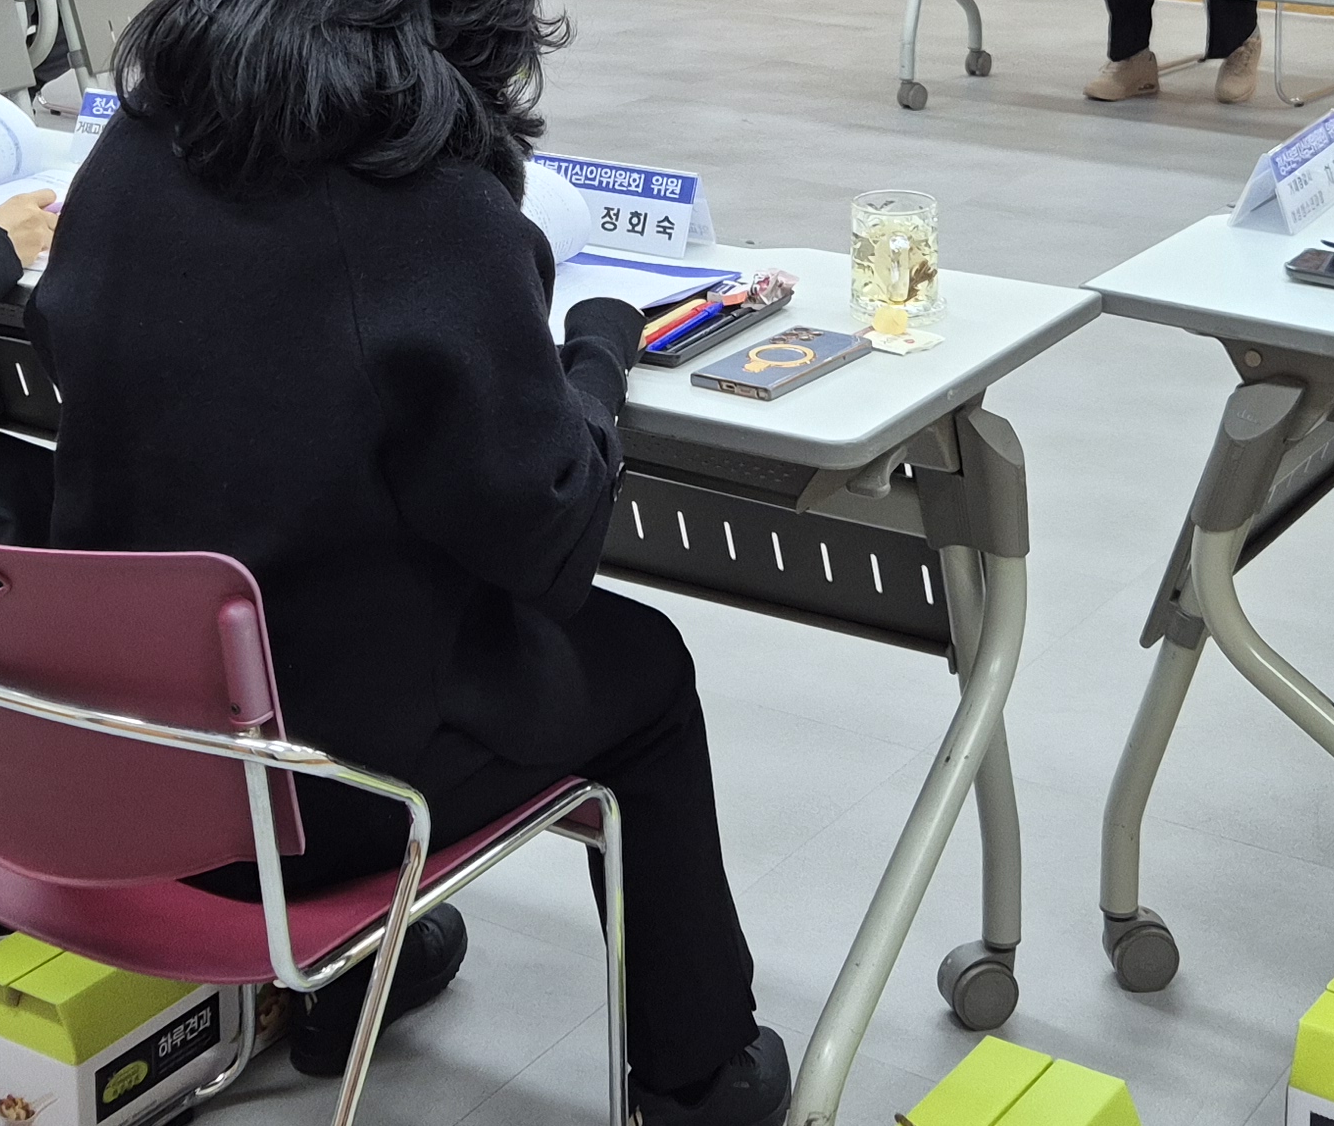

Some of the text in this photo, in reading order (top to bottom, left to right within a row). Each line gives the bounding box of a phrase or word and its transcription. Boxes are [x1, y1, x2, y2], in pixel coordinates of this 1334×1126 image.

[92, 97, 119, 115] 청소
[650, 176, 682, 198] 위원
[601, 206, 676, 240] 정회숙
[158, 1006, 212, 1058] 하루견과
